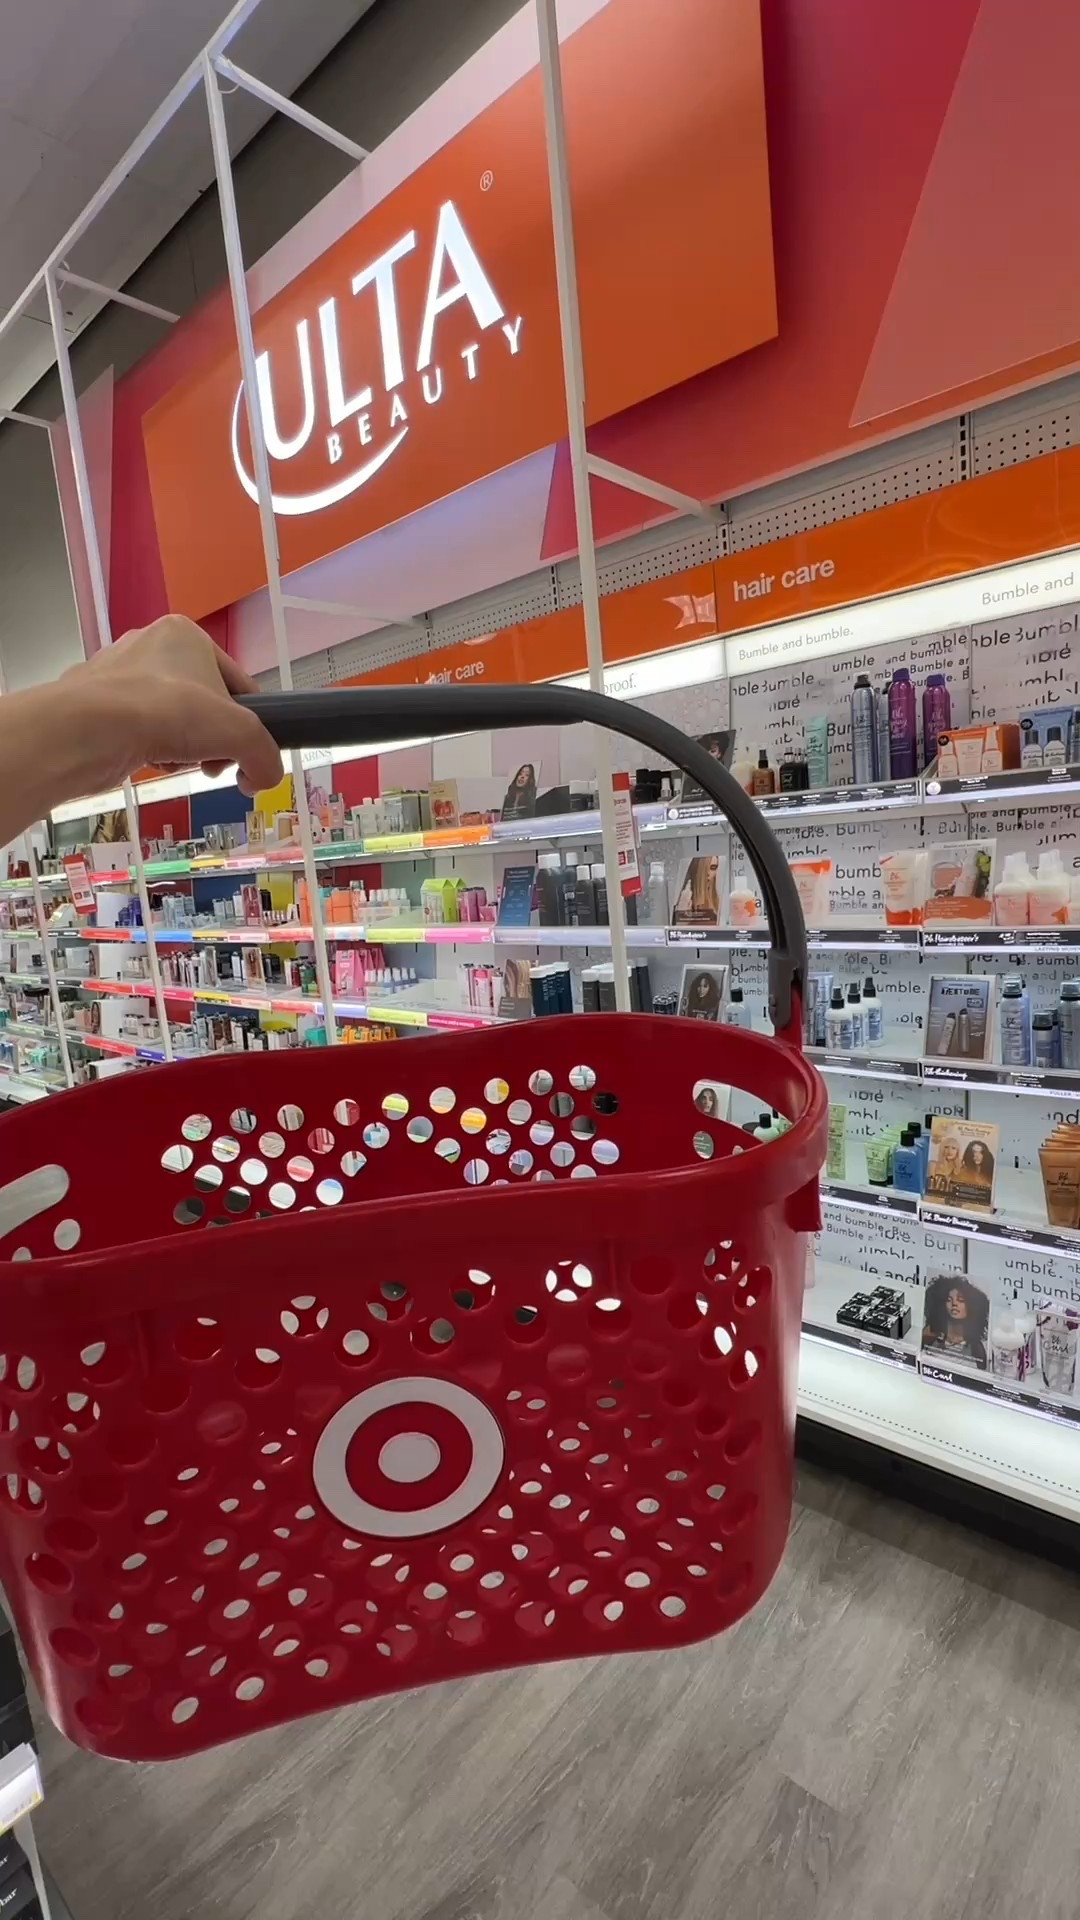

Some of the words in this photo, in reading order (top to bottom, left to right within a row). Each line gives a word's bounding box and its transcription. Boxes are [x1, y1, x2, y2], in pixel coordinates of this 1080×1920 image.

[255, 199, 505, 460] ULTA
[327, 316, 522, 464] BEAUTY
[733, 573, 775, 602] hair
[781, 559, 835, 588] care
[982, 581, 1039, 605] Bumble
[1044, 571, 1075, 591] and
[738, 643, 779, 661] Bumble
[781, 636, 803, 651] and
[806, 625, 854, 646] bumble.
[427, 667, 452, 685] hair
[455, 661, 484, 680] care
[910, 657, 954, 674] Bumble
[876, 981, 926, 994] umble.
[826, 1223, 864, 1241] Bumble
